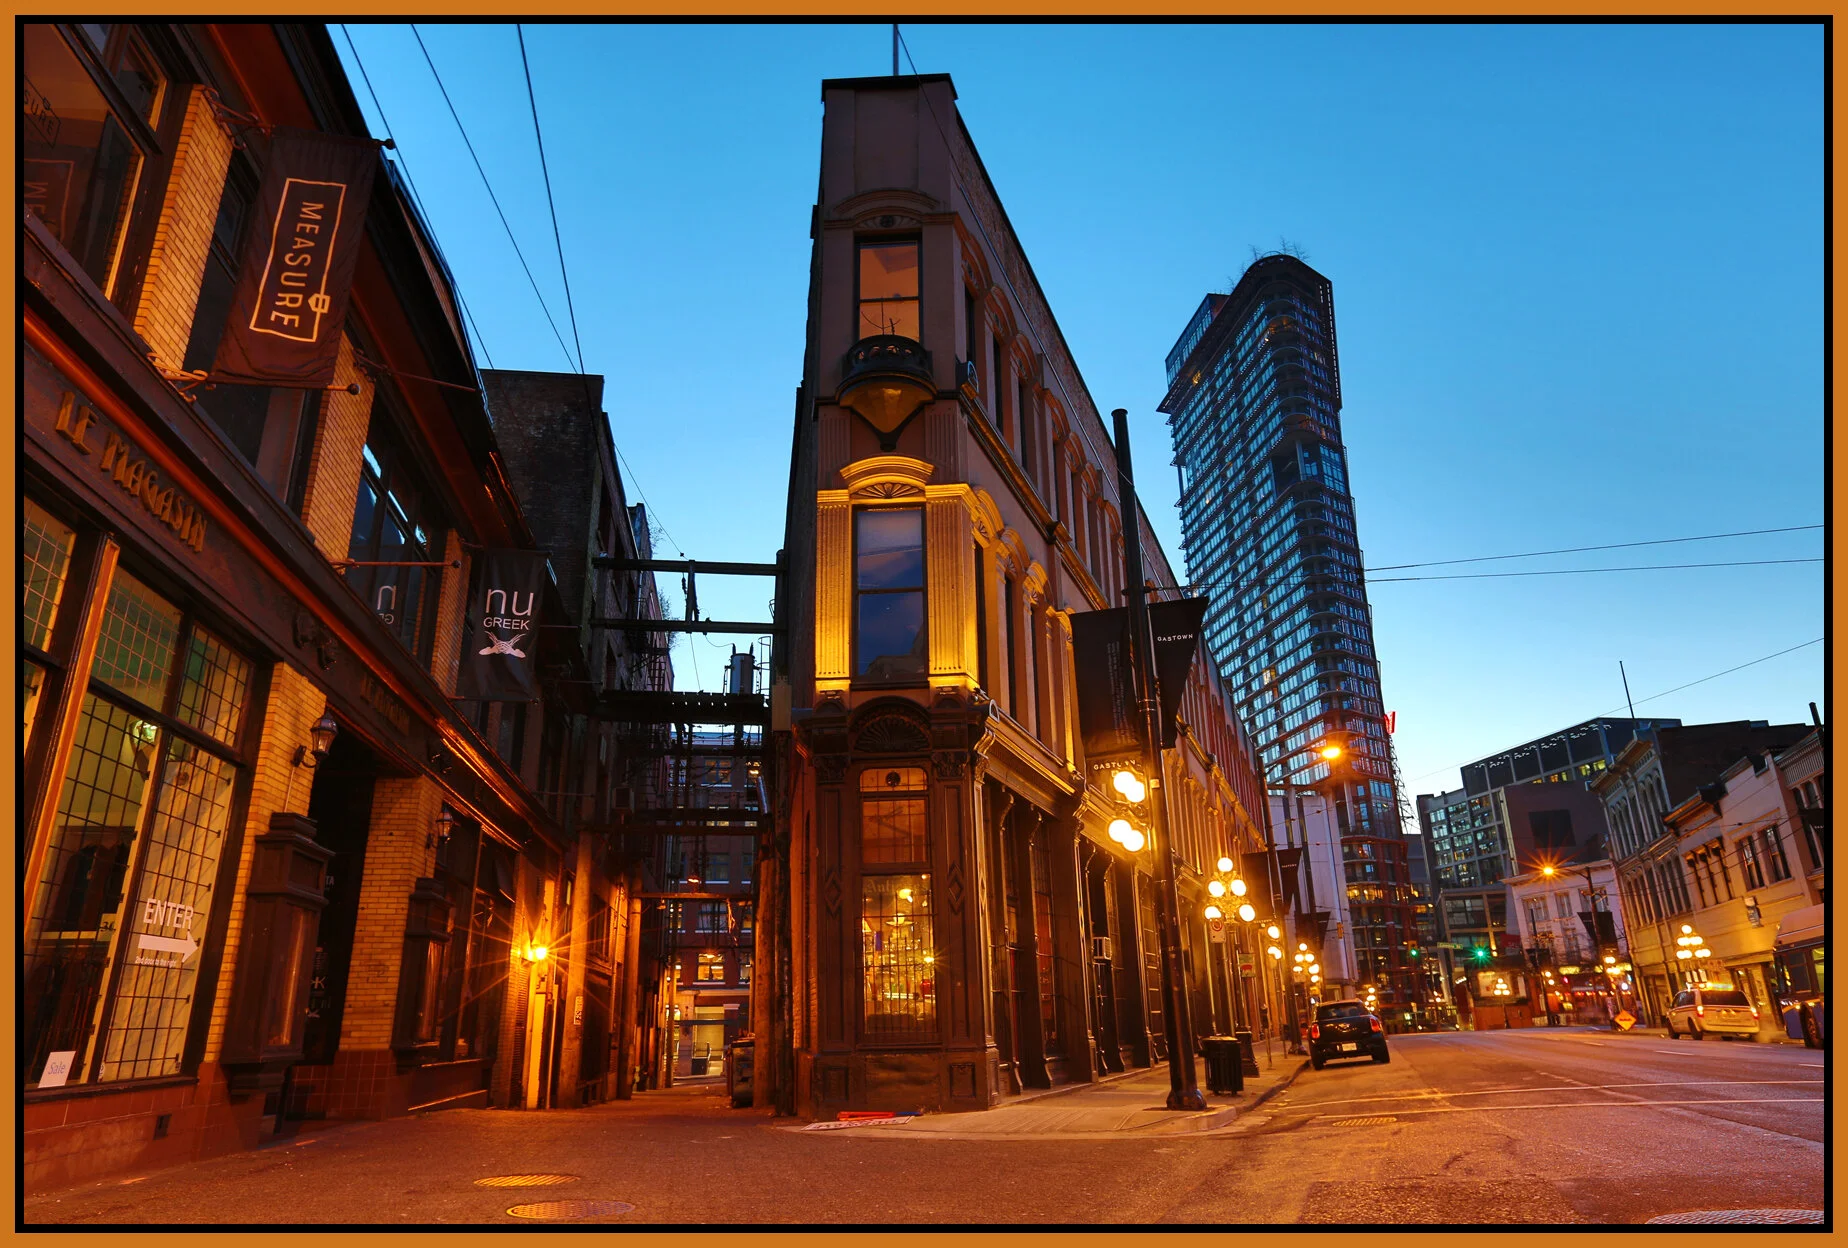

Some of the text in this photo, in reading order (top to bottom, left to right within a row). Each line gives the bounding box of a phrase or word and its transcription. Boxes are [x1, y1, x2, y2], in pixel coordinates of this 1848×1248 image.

[269, 201, 325, 328] MEASURE
[55, 391, 208, 553] LE MAGASIN
[485, 588, 534, 616] nu
[483, 616, 530, 630] GREEK
[1157, 633, 1194, 642] GASTOWN
[143, 898, 194, 930] ENTER
[47, 1061, 66, 1075] Sale
